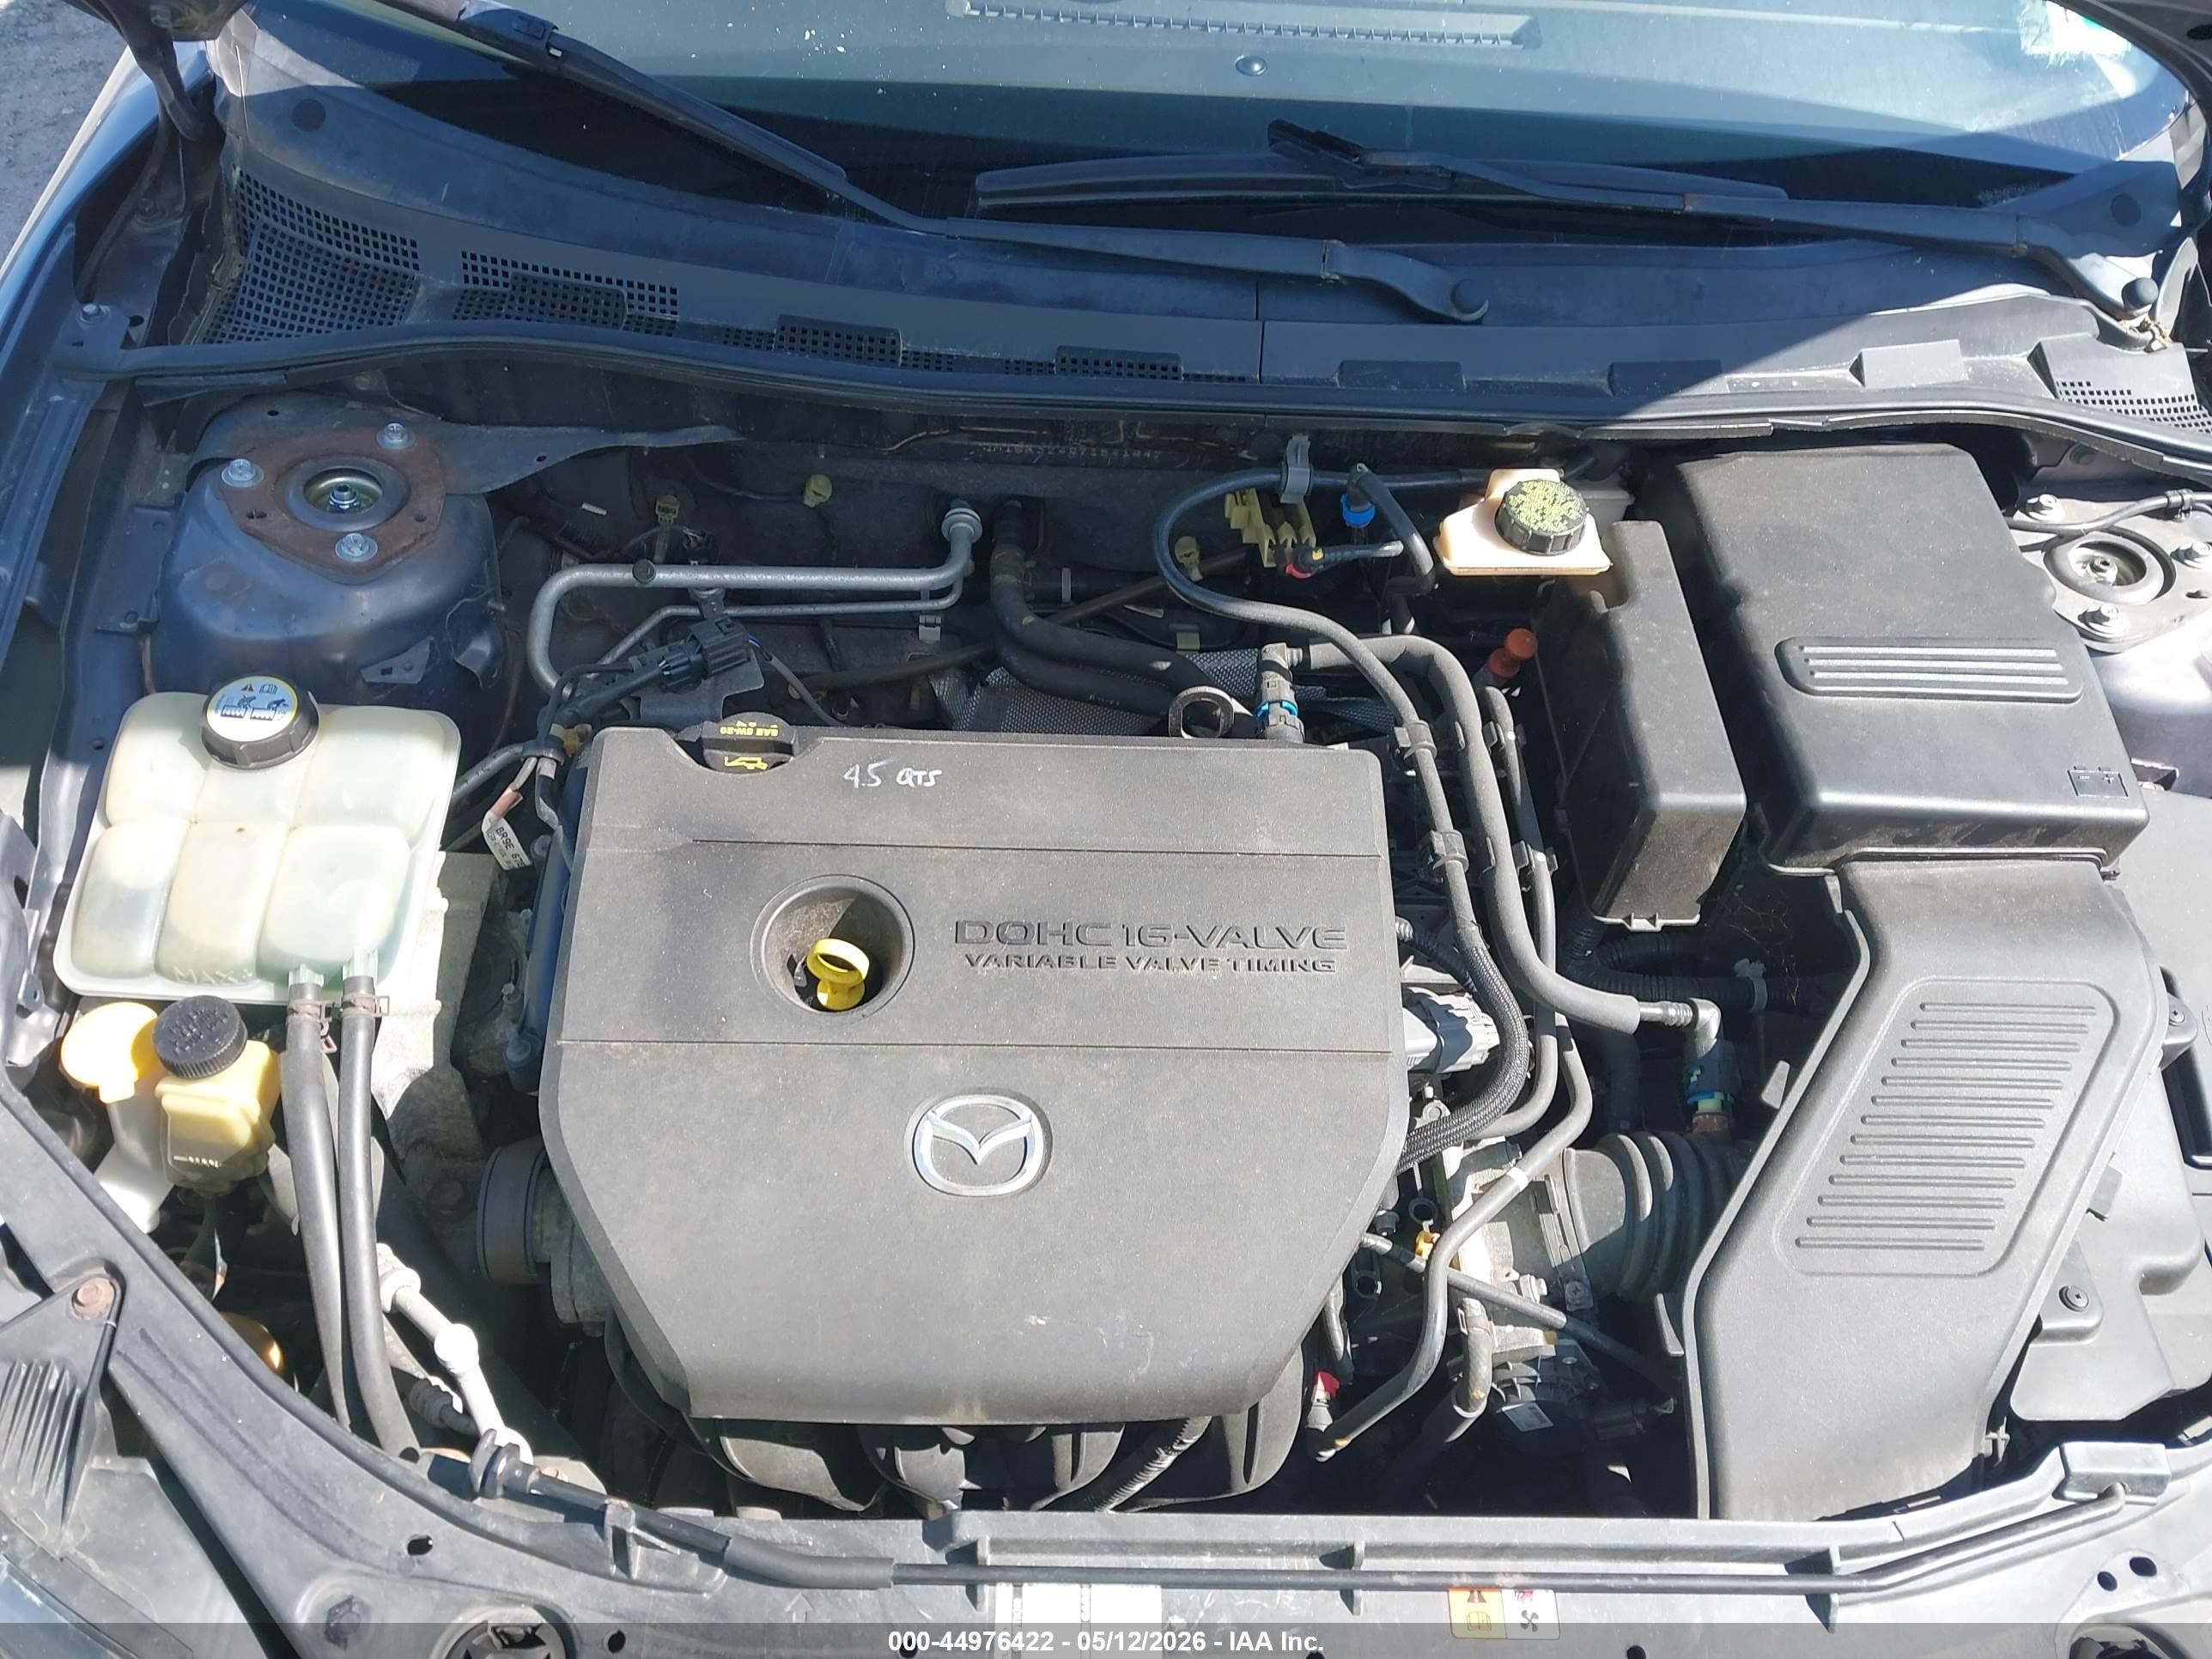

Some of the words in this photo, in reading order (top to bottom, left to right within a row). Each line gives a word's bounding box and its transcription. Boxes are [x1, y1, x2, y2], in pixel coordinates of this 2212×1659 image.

[896, 768, 943, 787] QTS
[954, 921, 1112, 946] DOHC
[1121, 921, 1347, 950] 16-VALVE
[964, 953, 1116, 969] VARIABLE
[1125, 955, 1219, 972] VALVE
[1226, 957, 1336, 973] TIMING
